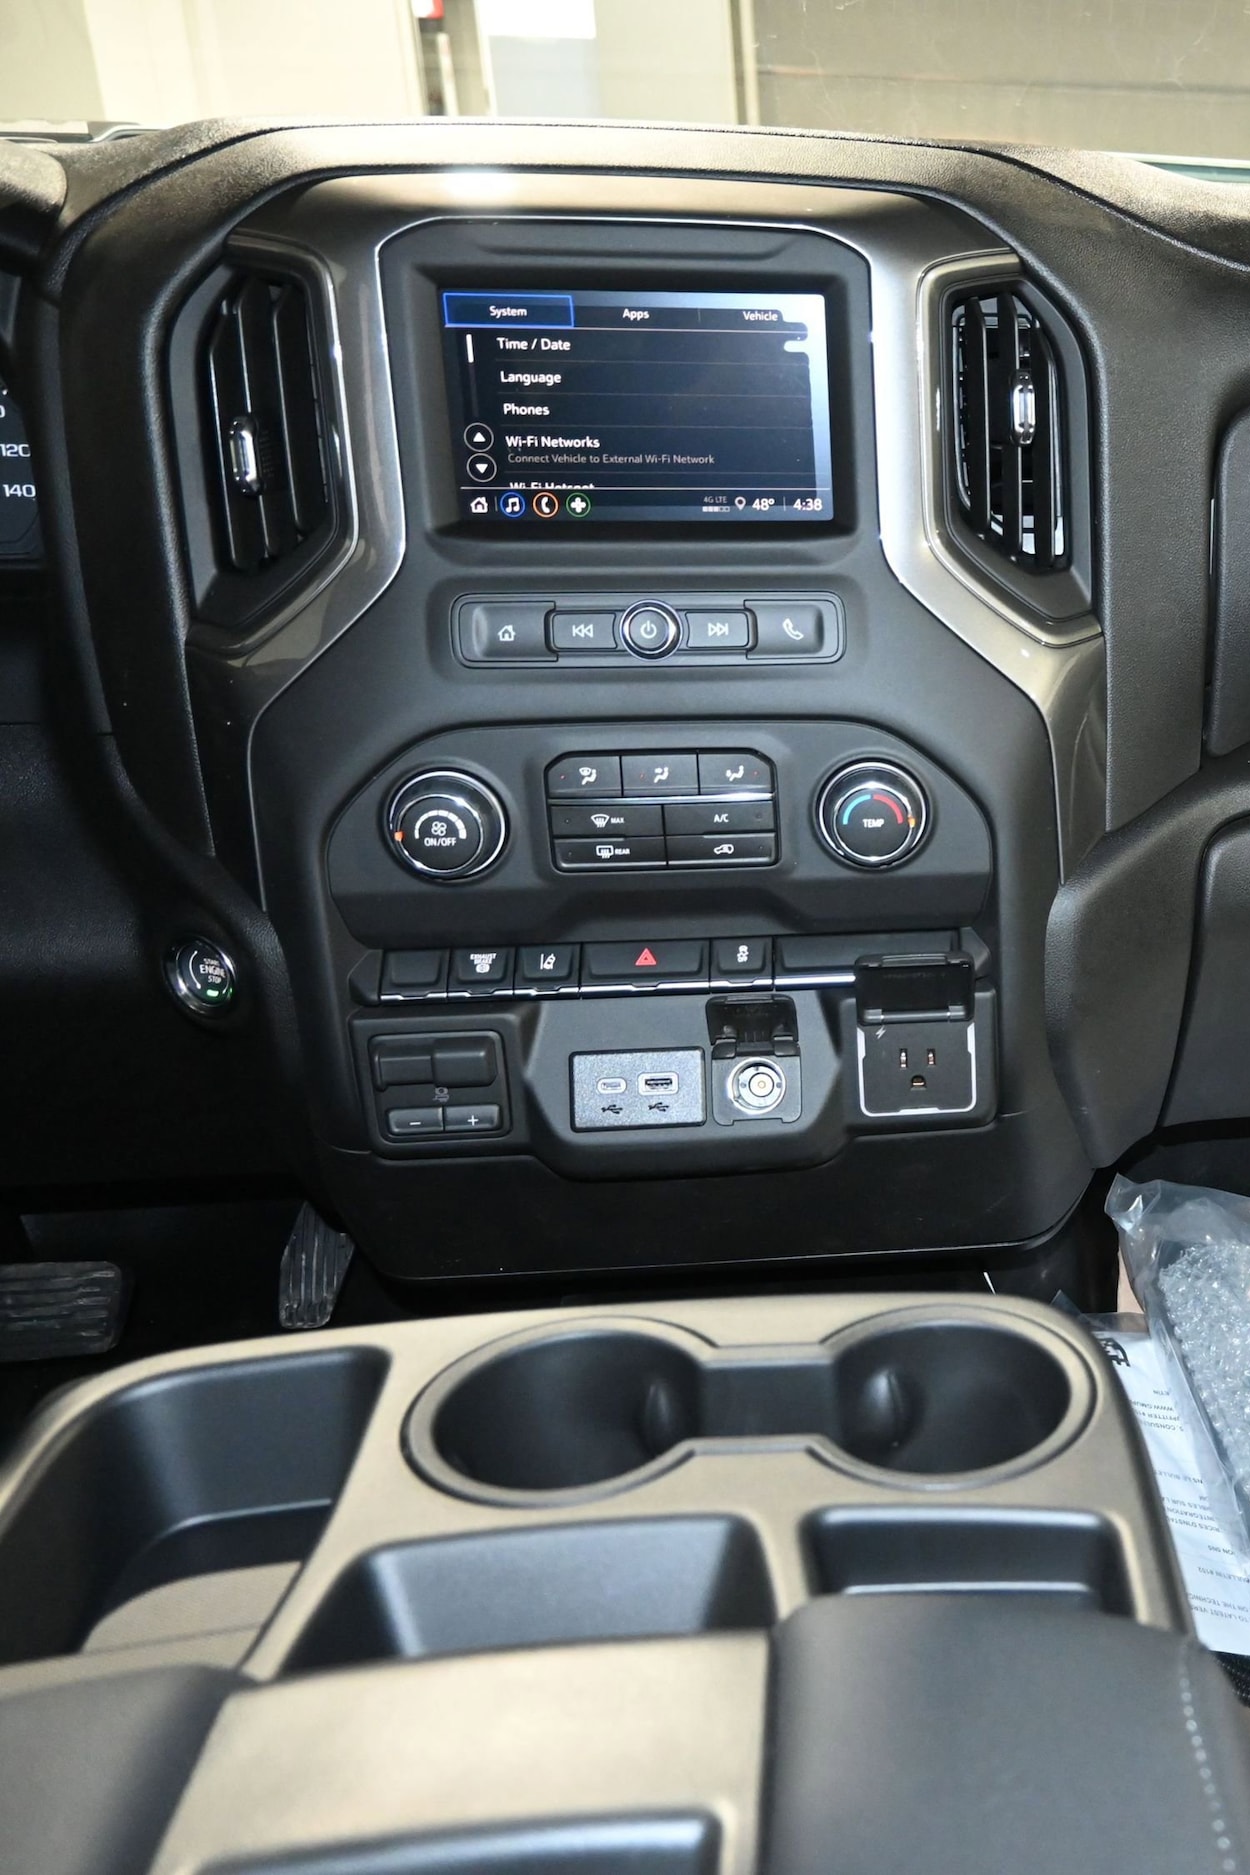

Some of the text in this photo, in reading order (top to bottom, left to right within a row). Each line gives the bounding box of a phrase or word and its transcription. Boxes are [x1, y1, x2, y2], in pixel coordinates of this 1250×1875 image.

[489, 306, 527, 319] System
[622, 308, 649, 321] Apps
[742, 310, 779, 321] Vehicle
[496, 337, 571, 351] Time / Date
[500, 371, 561, 386] Language
[503, 403, 550, 416] Phones
[505, 436, 600, 448] Wi-Fi Networks
[507, 453, 715, 464] Connect Vehicle to External Wi-Fi Network
[3, 484, 36, 498] 140
[703, 495, 728, 504] 4G LTE
[793, 498, 823, 511] 4:38
[713, 813, 729, 823] A/C
[862, 818, 885, 828] TEMP
[424, 837, 457, 847] ON/OFF
